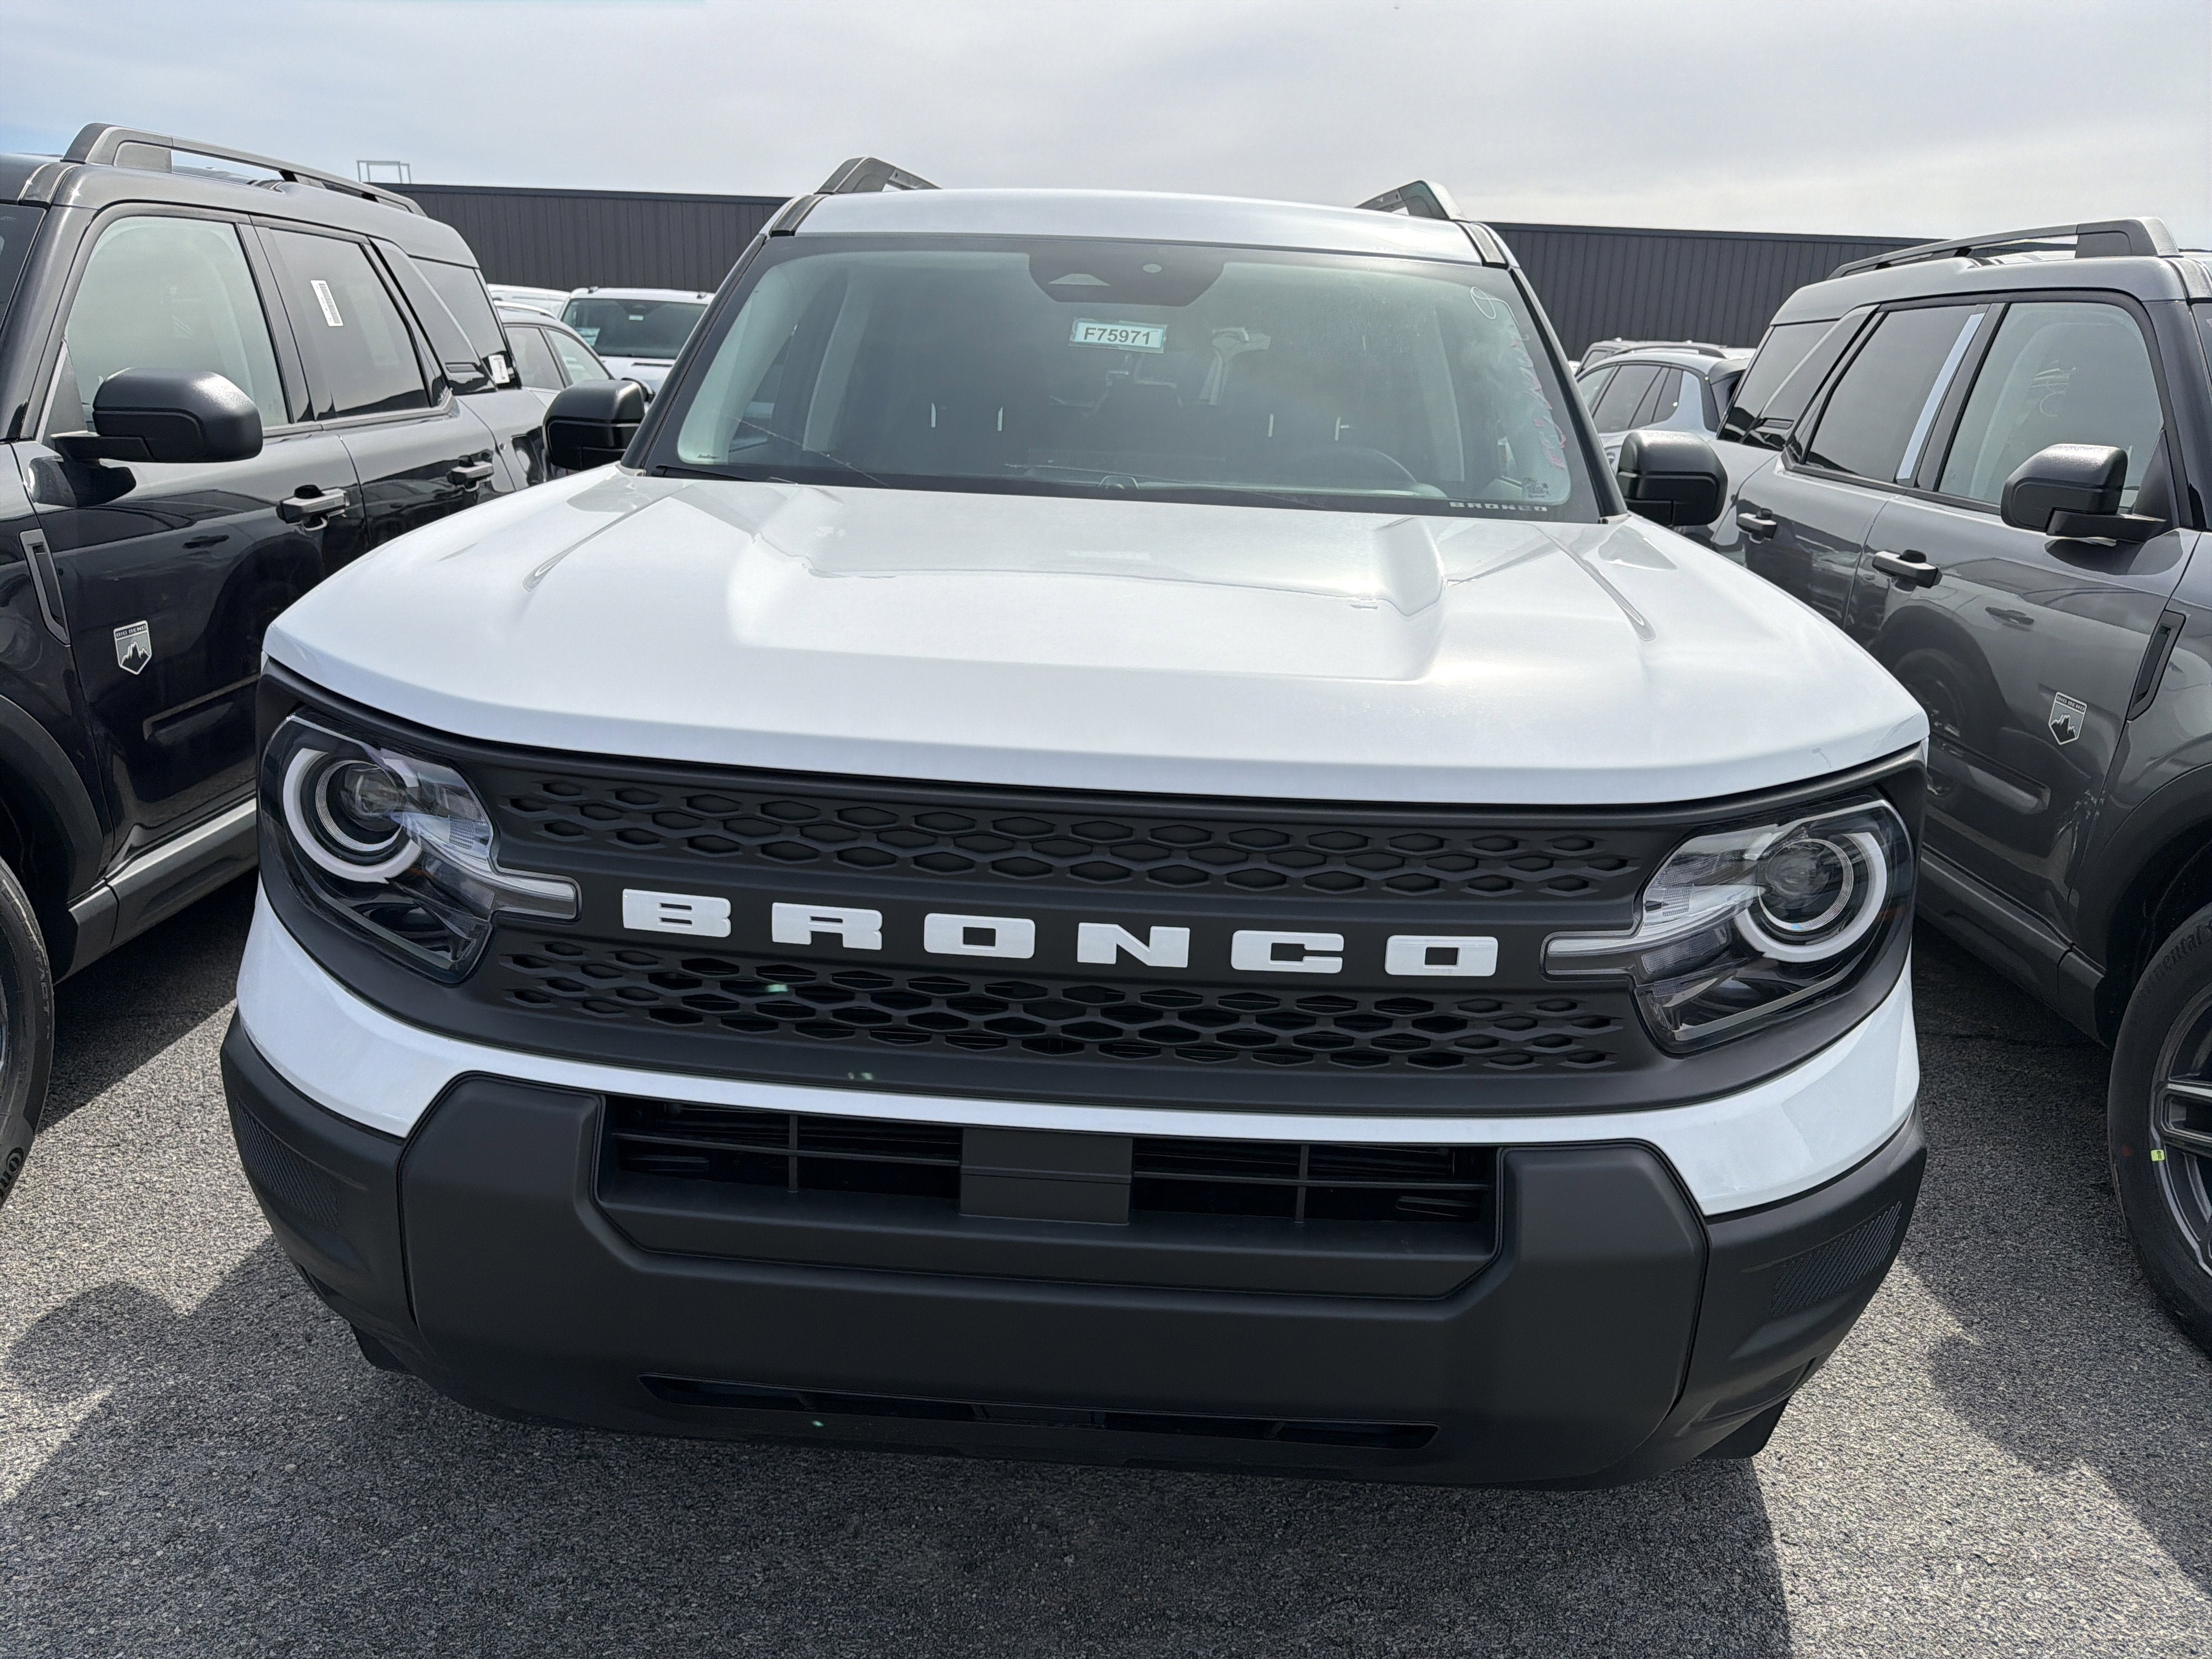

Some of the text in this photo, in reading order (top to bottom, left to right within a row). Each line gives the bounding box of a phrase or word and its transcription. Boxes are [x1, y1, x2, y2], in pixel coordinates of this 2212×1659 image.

[1084, 327, 1150, 345] F75971
[1449, 501, 1548, 512] BRONCO
[128, 624, 147, 634] BEND
[2068, 700, 2085, 712] BEND
[622, 888, 1499, 977] BRONCO
